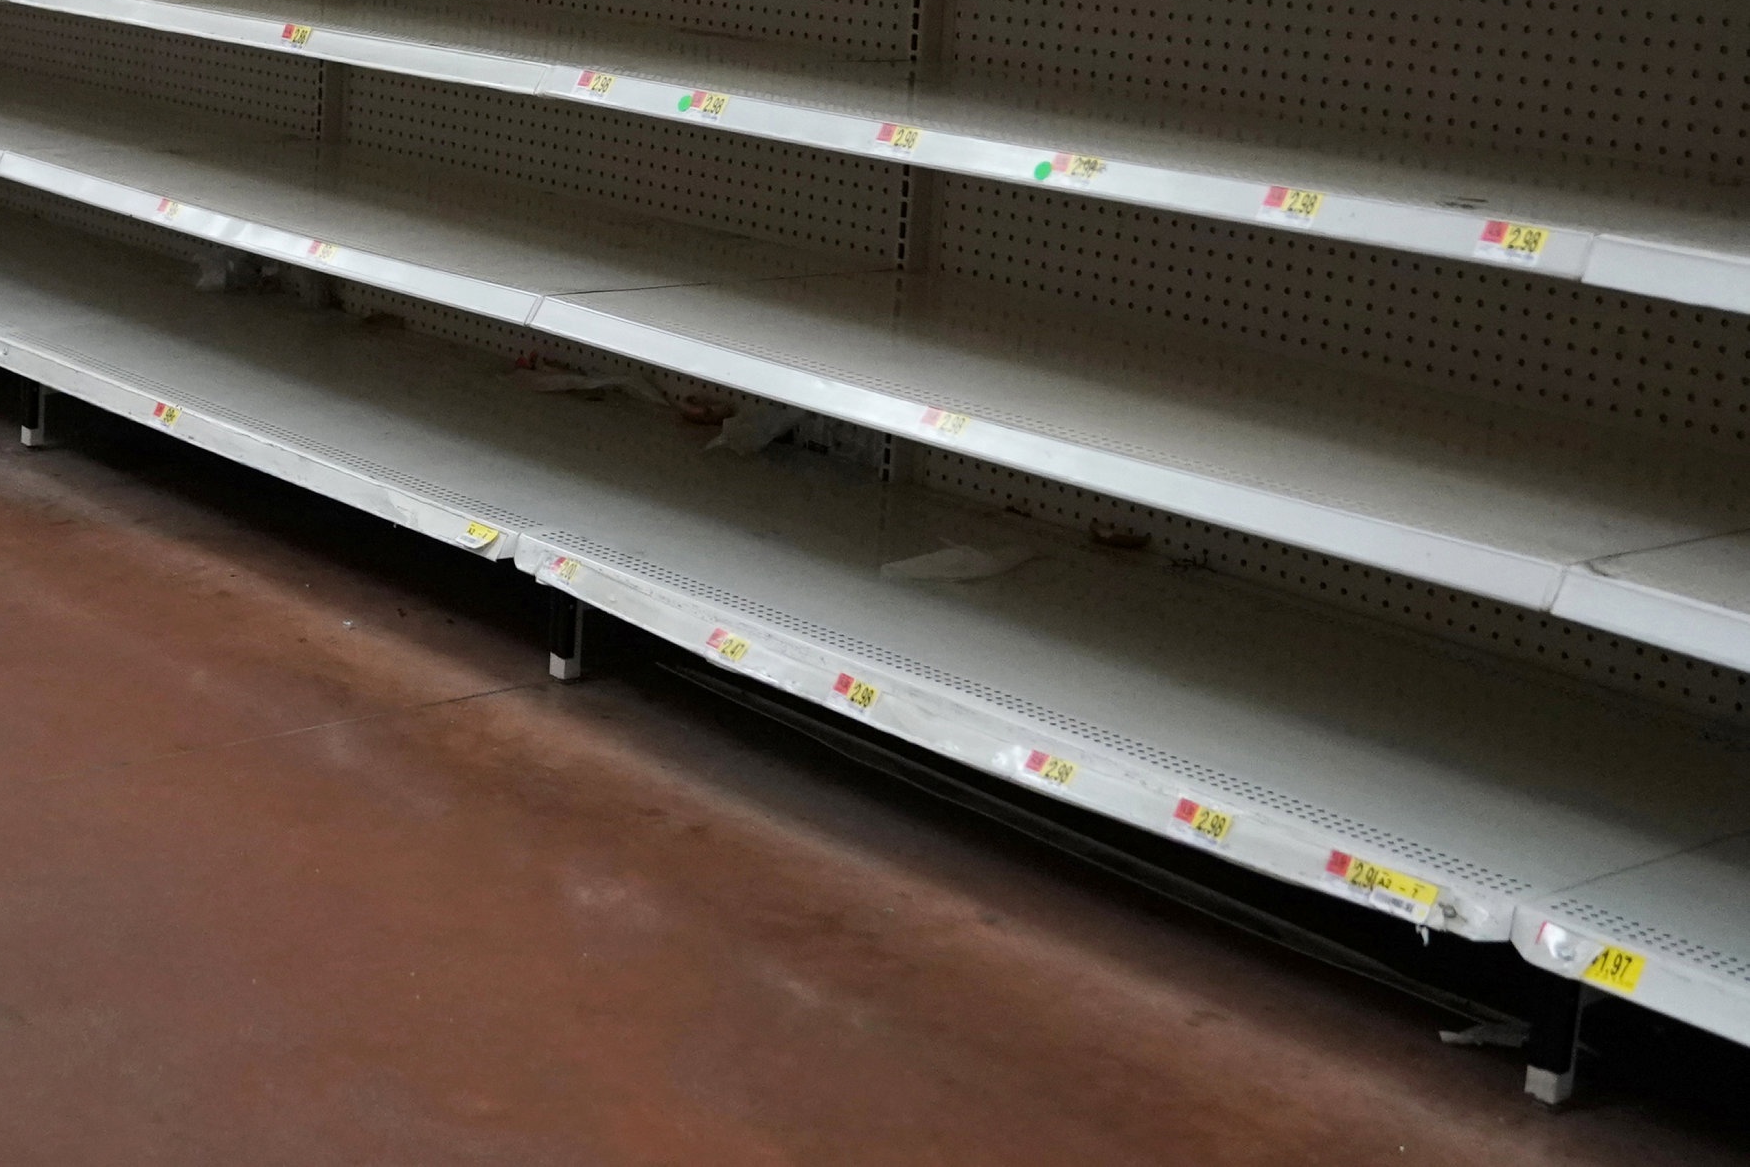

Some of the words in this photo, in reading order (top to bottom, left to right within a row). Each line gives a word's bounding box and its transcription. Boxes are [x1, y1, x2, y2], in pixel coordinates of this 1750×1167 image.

[1287, 190, 1318, 215] 2.98
[1507, 226, 1542, 253] 2.98
[849, 683, 875, 708] 2.98
[1045, 759, 1073, 784] 2.98
[1196, 810, 1226, 838] 2.98
[1600, 948, 1632, 979] 1.97
